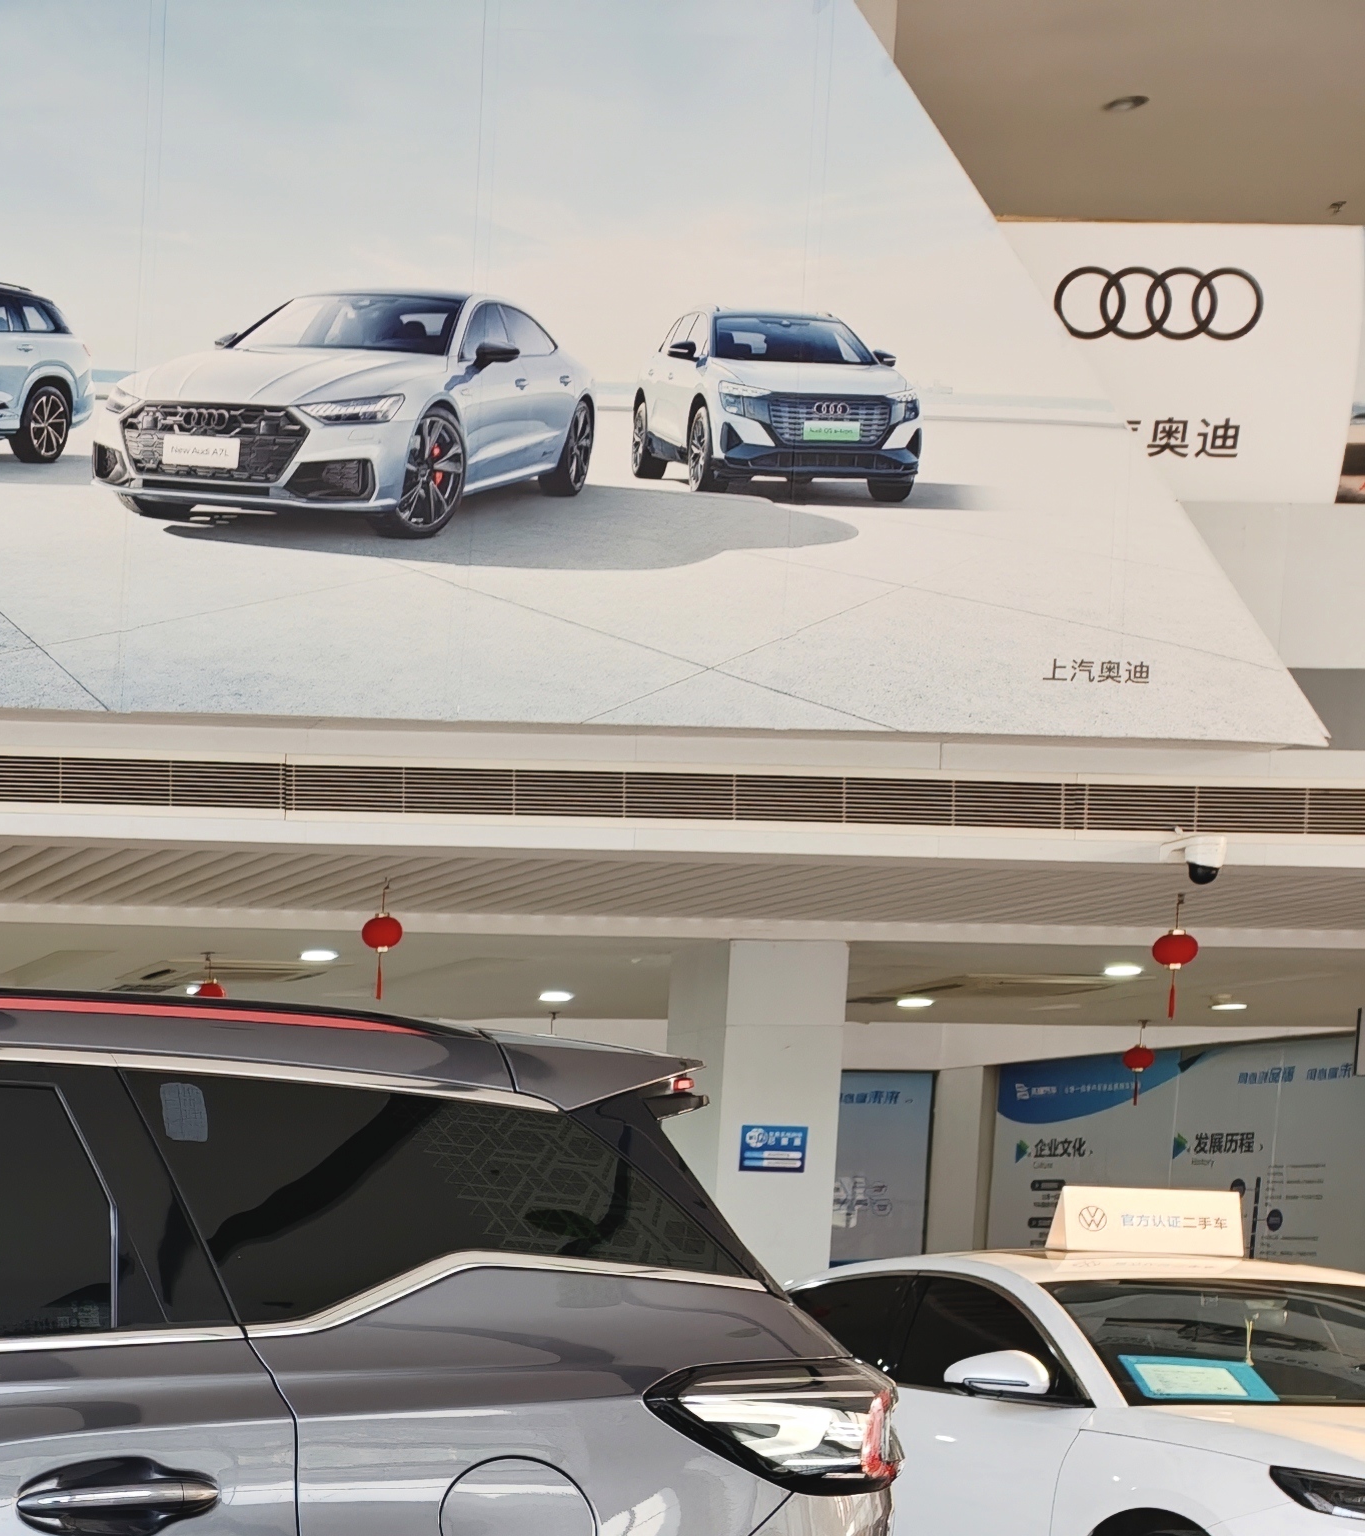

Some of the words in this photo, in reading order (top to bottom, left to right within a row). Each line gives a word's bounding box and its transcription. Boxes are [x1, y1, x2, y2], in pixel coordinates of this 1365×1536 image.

[1126, 416, 1241, 458] 奥迪
[211, 448, 230, 457] A7L
[1042, 658, 1150, 684] 上汽奥迪
[1033, 1136, 1087, 1159] 企业文化
[1193, 1131, 1256, 1155] 发展历程
[1120, 1213, 1229, 1230] 官方认证二手车
